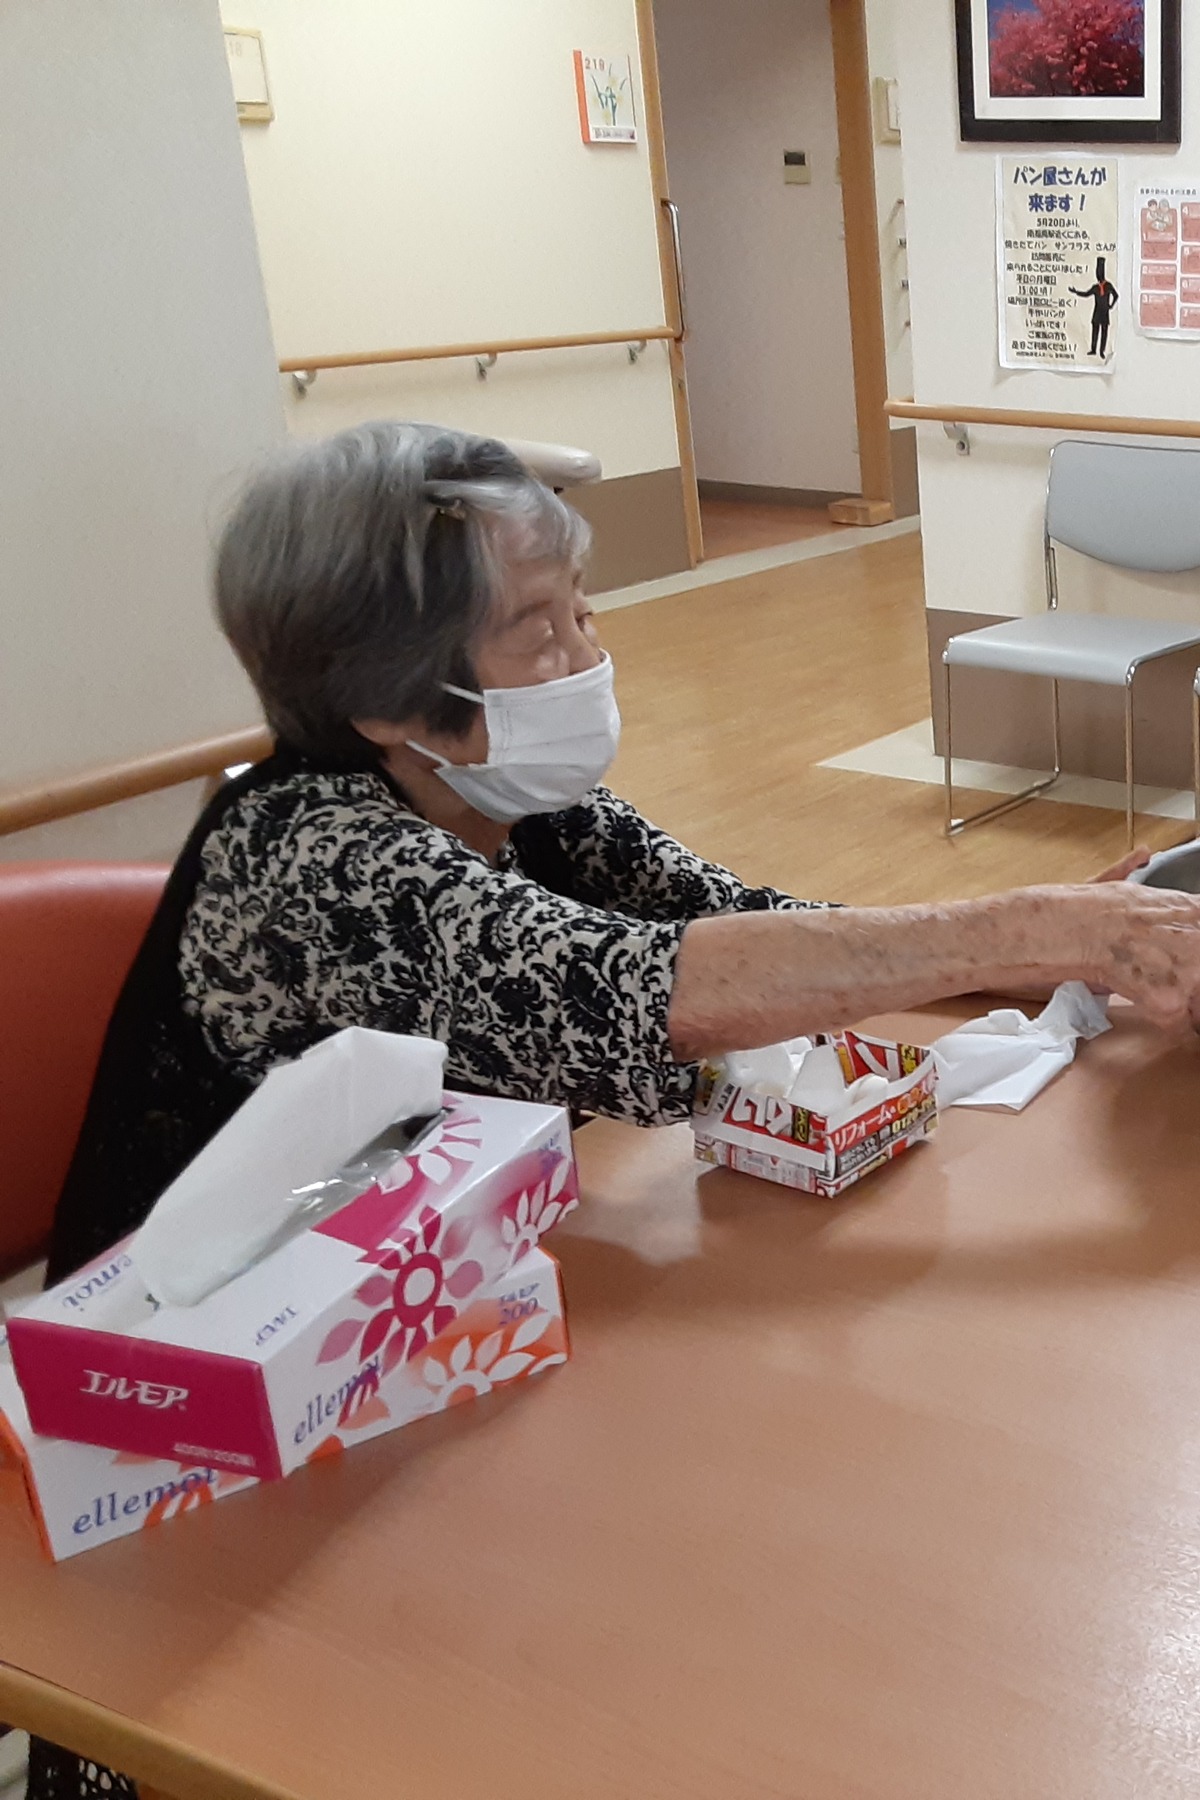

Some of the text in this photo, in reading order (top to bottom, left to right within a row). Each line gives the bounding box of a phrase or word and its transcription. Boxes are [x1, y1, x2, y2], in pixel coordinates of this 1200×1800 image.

[1013, 165, 1107, 187] パン屋さんが
